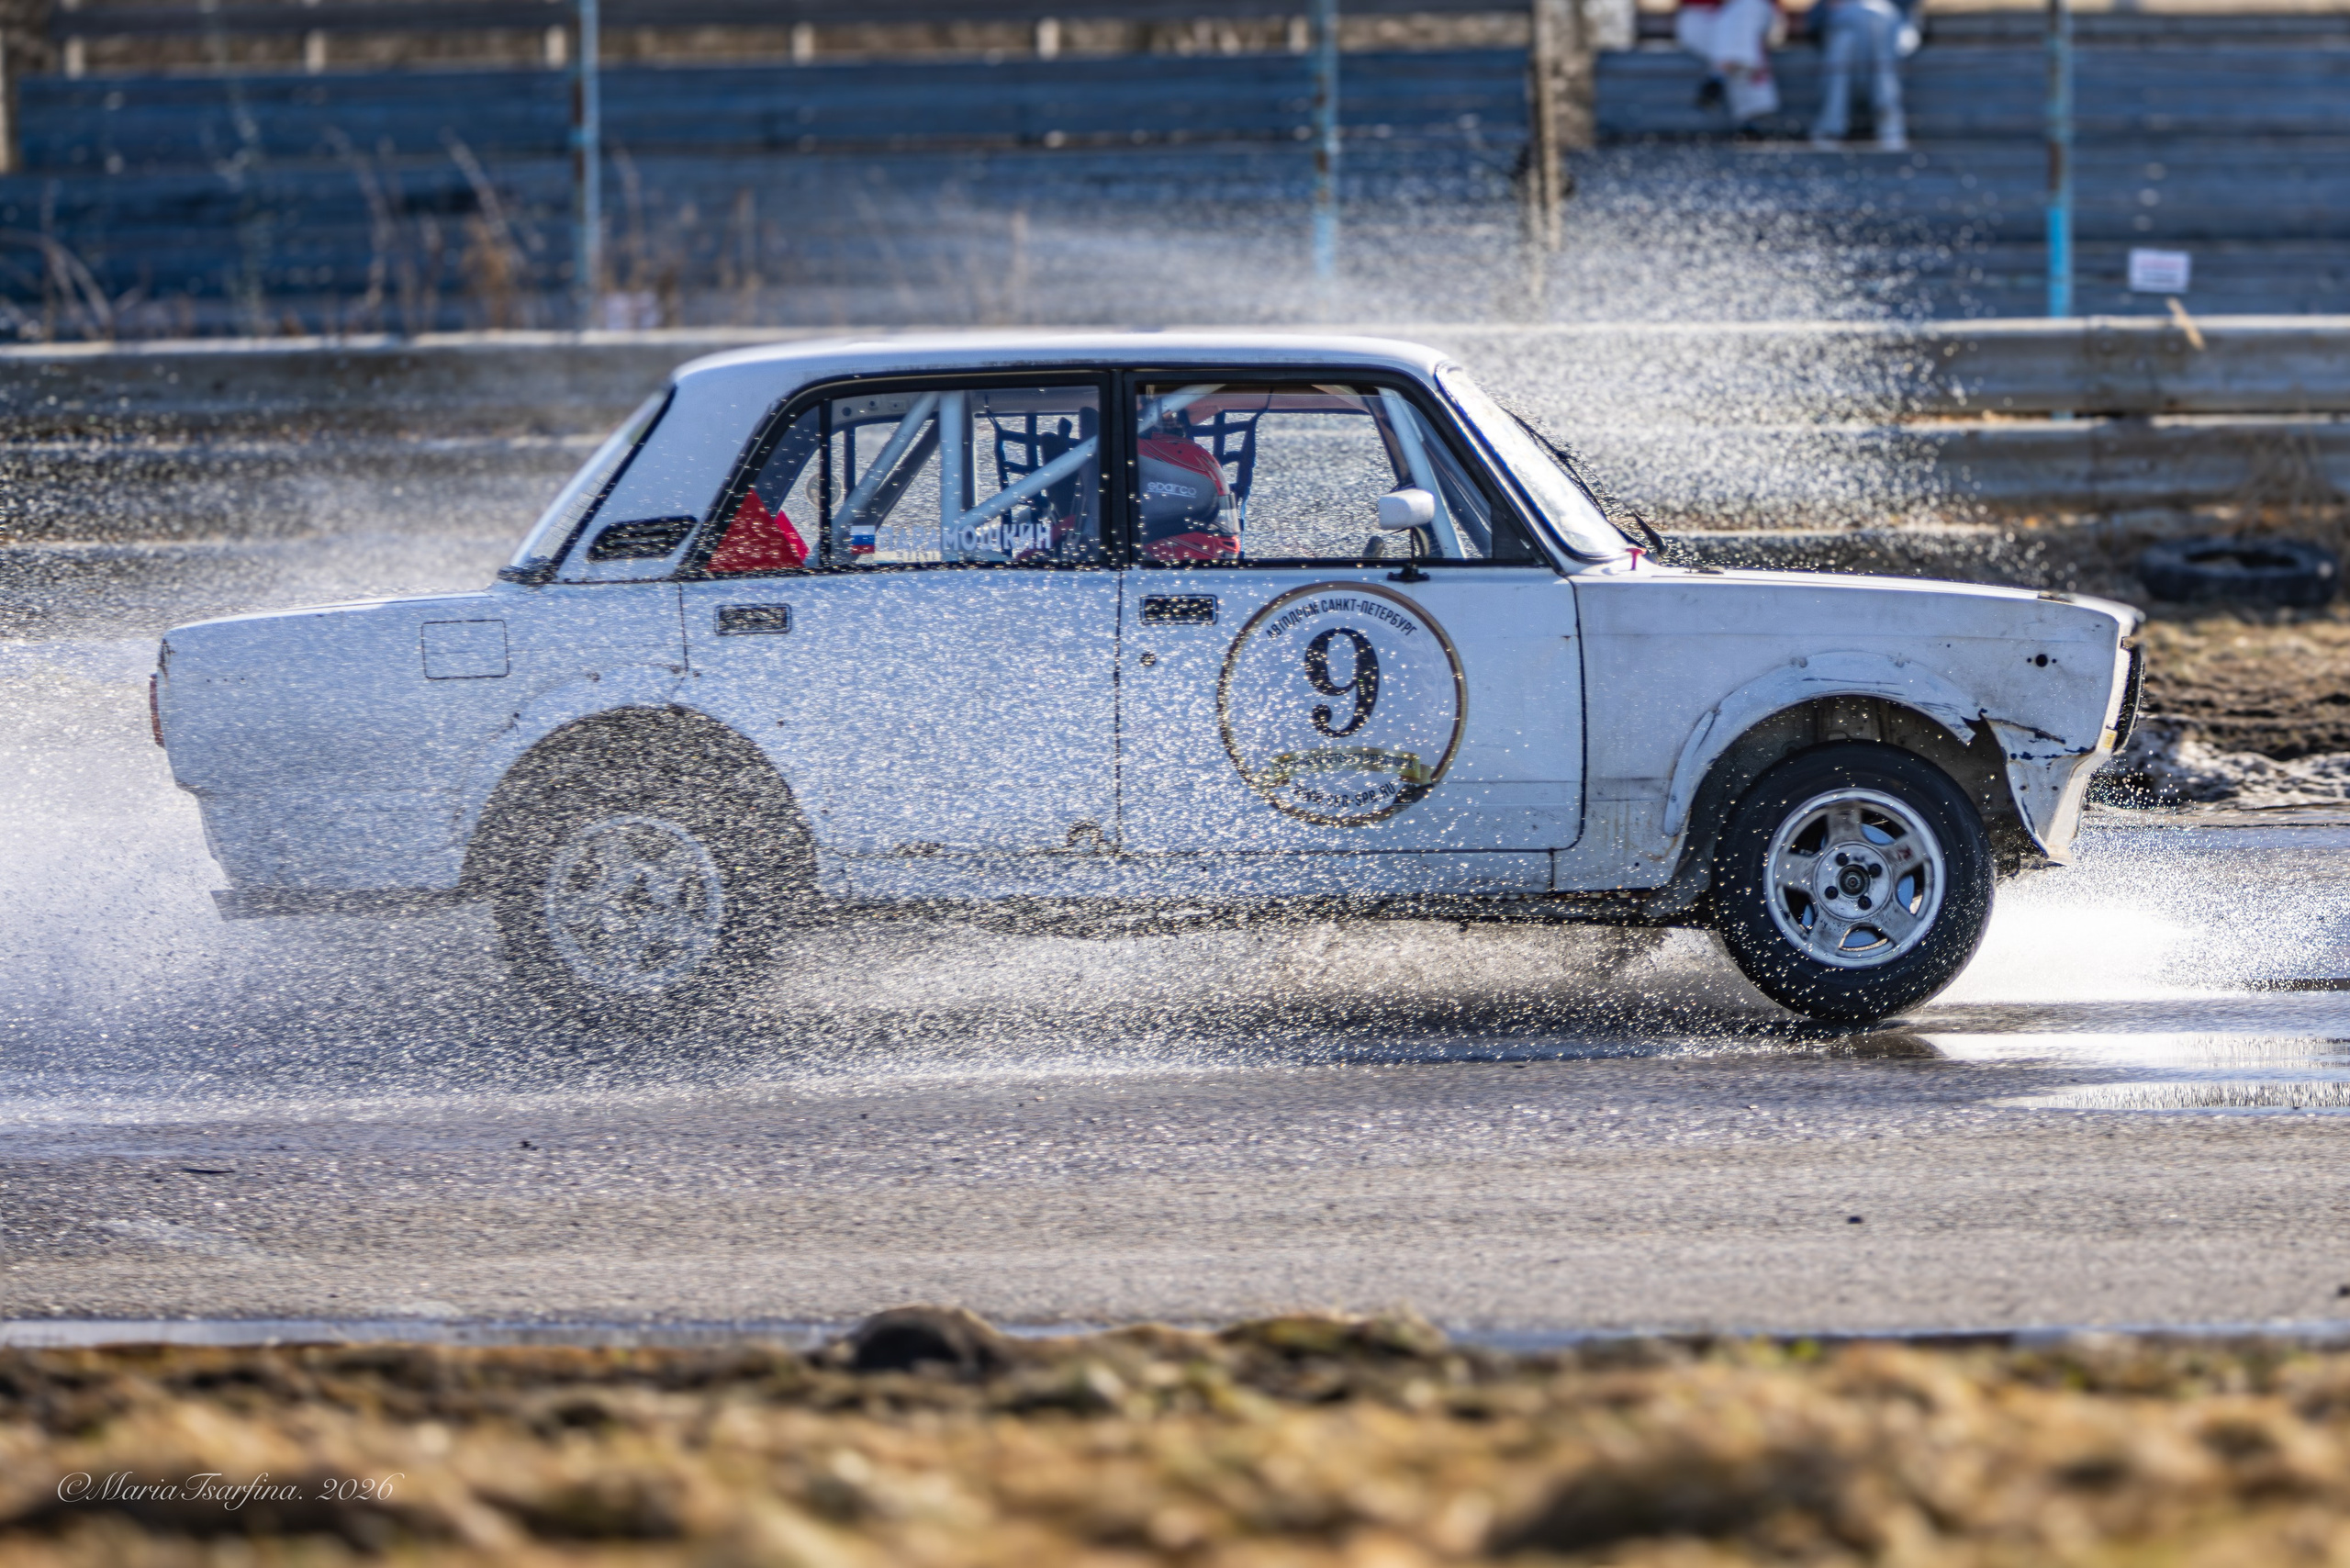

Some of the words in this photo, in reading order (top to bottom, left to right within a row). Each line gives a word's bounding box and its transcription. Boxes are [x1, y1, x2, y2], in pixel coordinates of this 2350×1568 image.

[1147, 481, 1197, 497] sparco
[1266, 602, 1320, 639] АВТОДРОМ
[1320, 598, 1417, 636] САНКТ-ПЕТЕРБУРГ
[1304, 627, 1380, 739] 9
[1362, 753, 1415, 769] АВТСПОРТА
